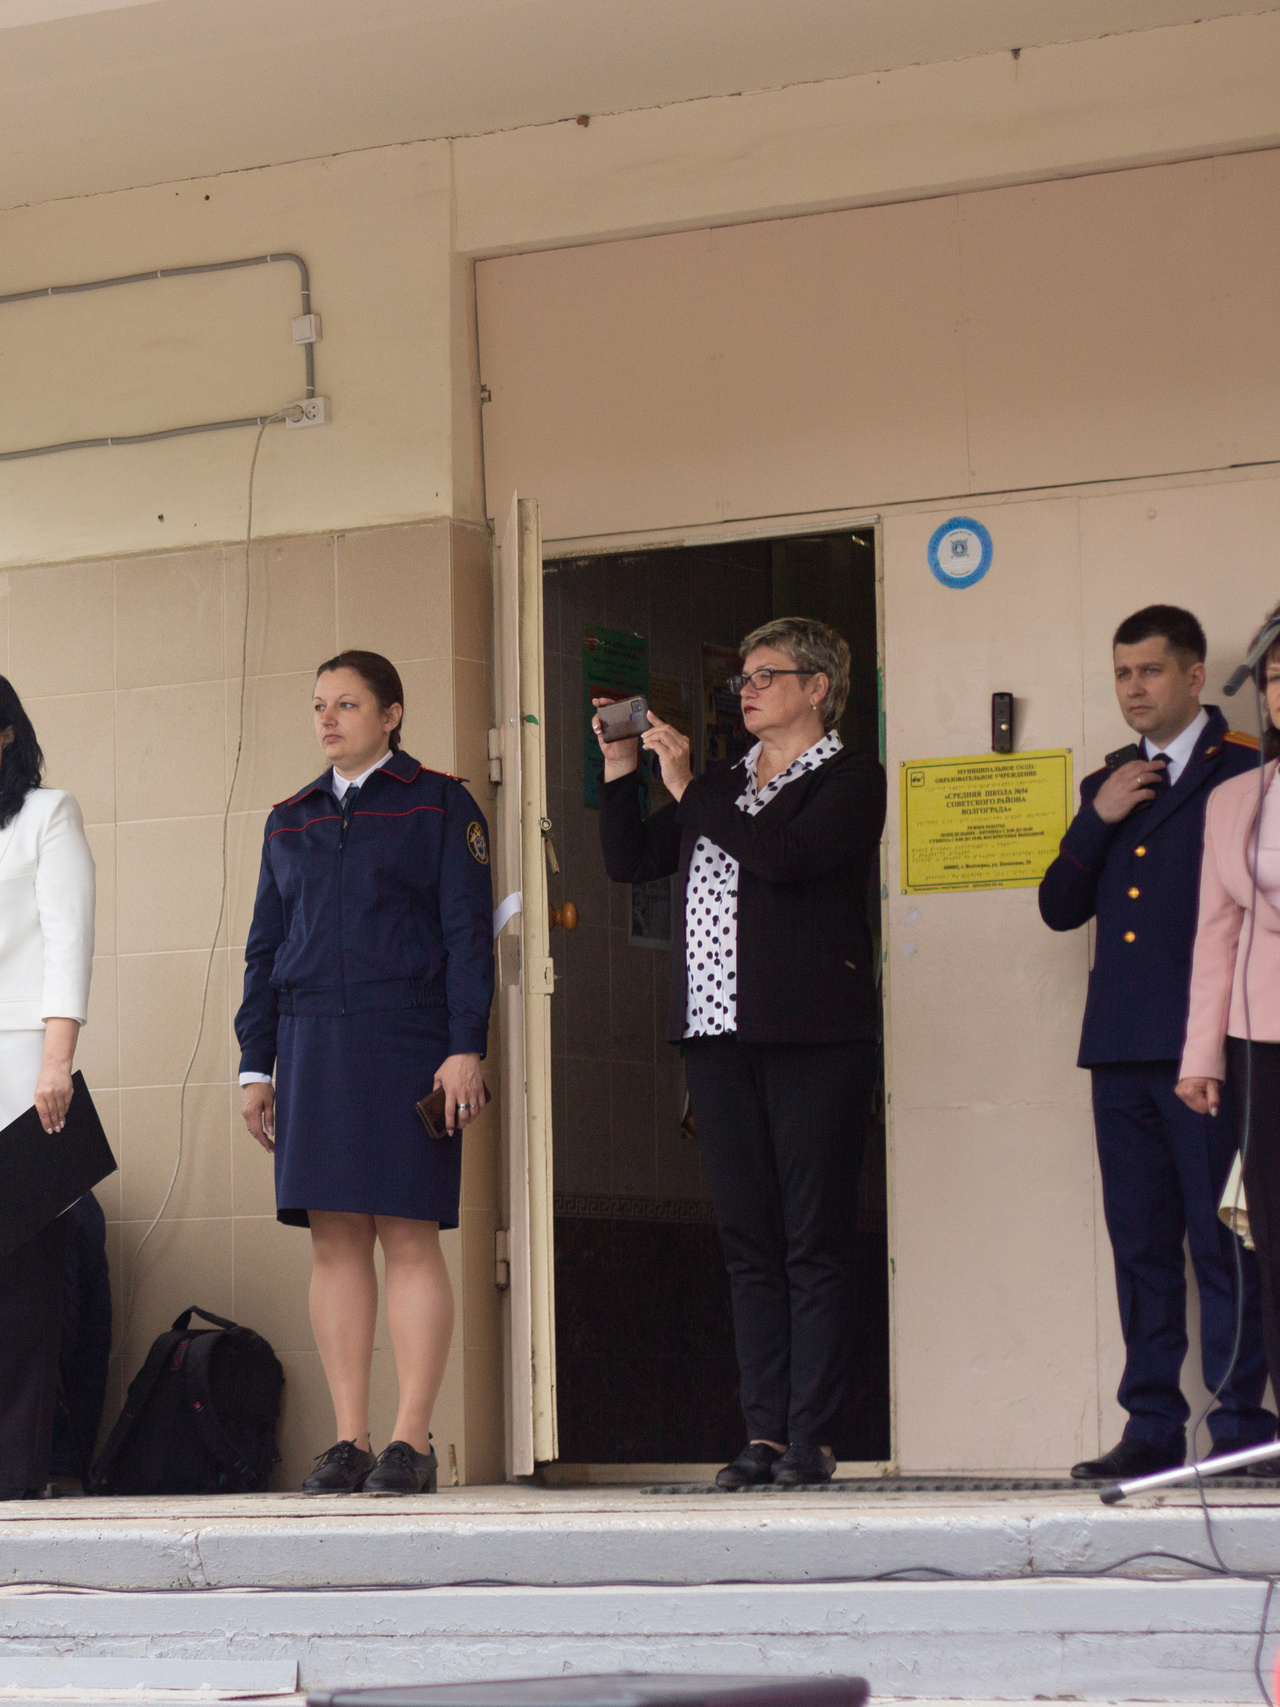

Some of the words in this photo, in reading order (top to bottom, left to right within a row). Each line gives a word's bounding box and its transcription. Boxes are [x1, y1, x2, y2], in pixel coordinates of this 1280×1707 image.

[957, 765, 1014, 775] МУНИЦИПАЛЬНОЕ
[935, 773, 993, 784] ОБРАЗОВАТЕЛЬНОЕ
[995, 770, 1037, 780] УЧРЕЖДЕНИЕ
[944, 790, 982, 800] «СРЕДНЯЯ
[985, 788, 1012, 797] ШКОЛА
[946, 798, 996, 808] СОВЕТСКОГО
[996, 795, 1026, 805] РАЙОНА
[961, 805, 1012, 816] ВОЛГОГРАДА»
